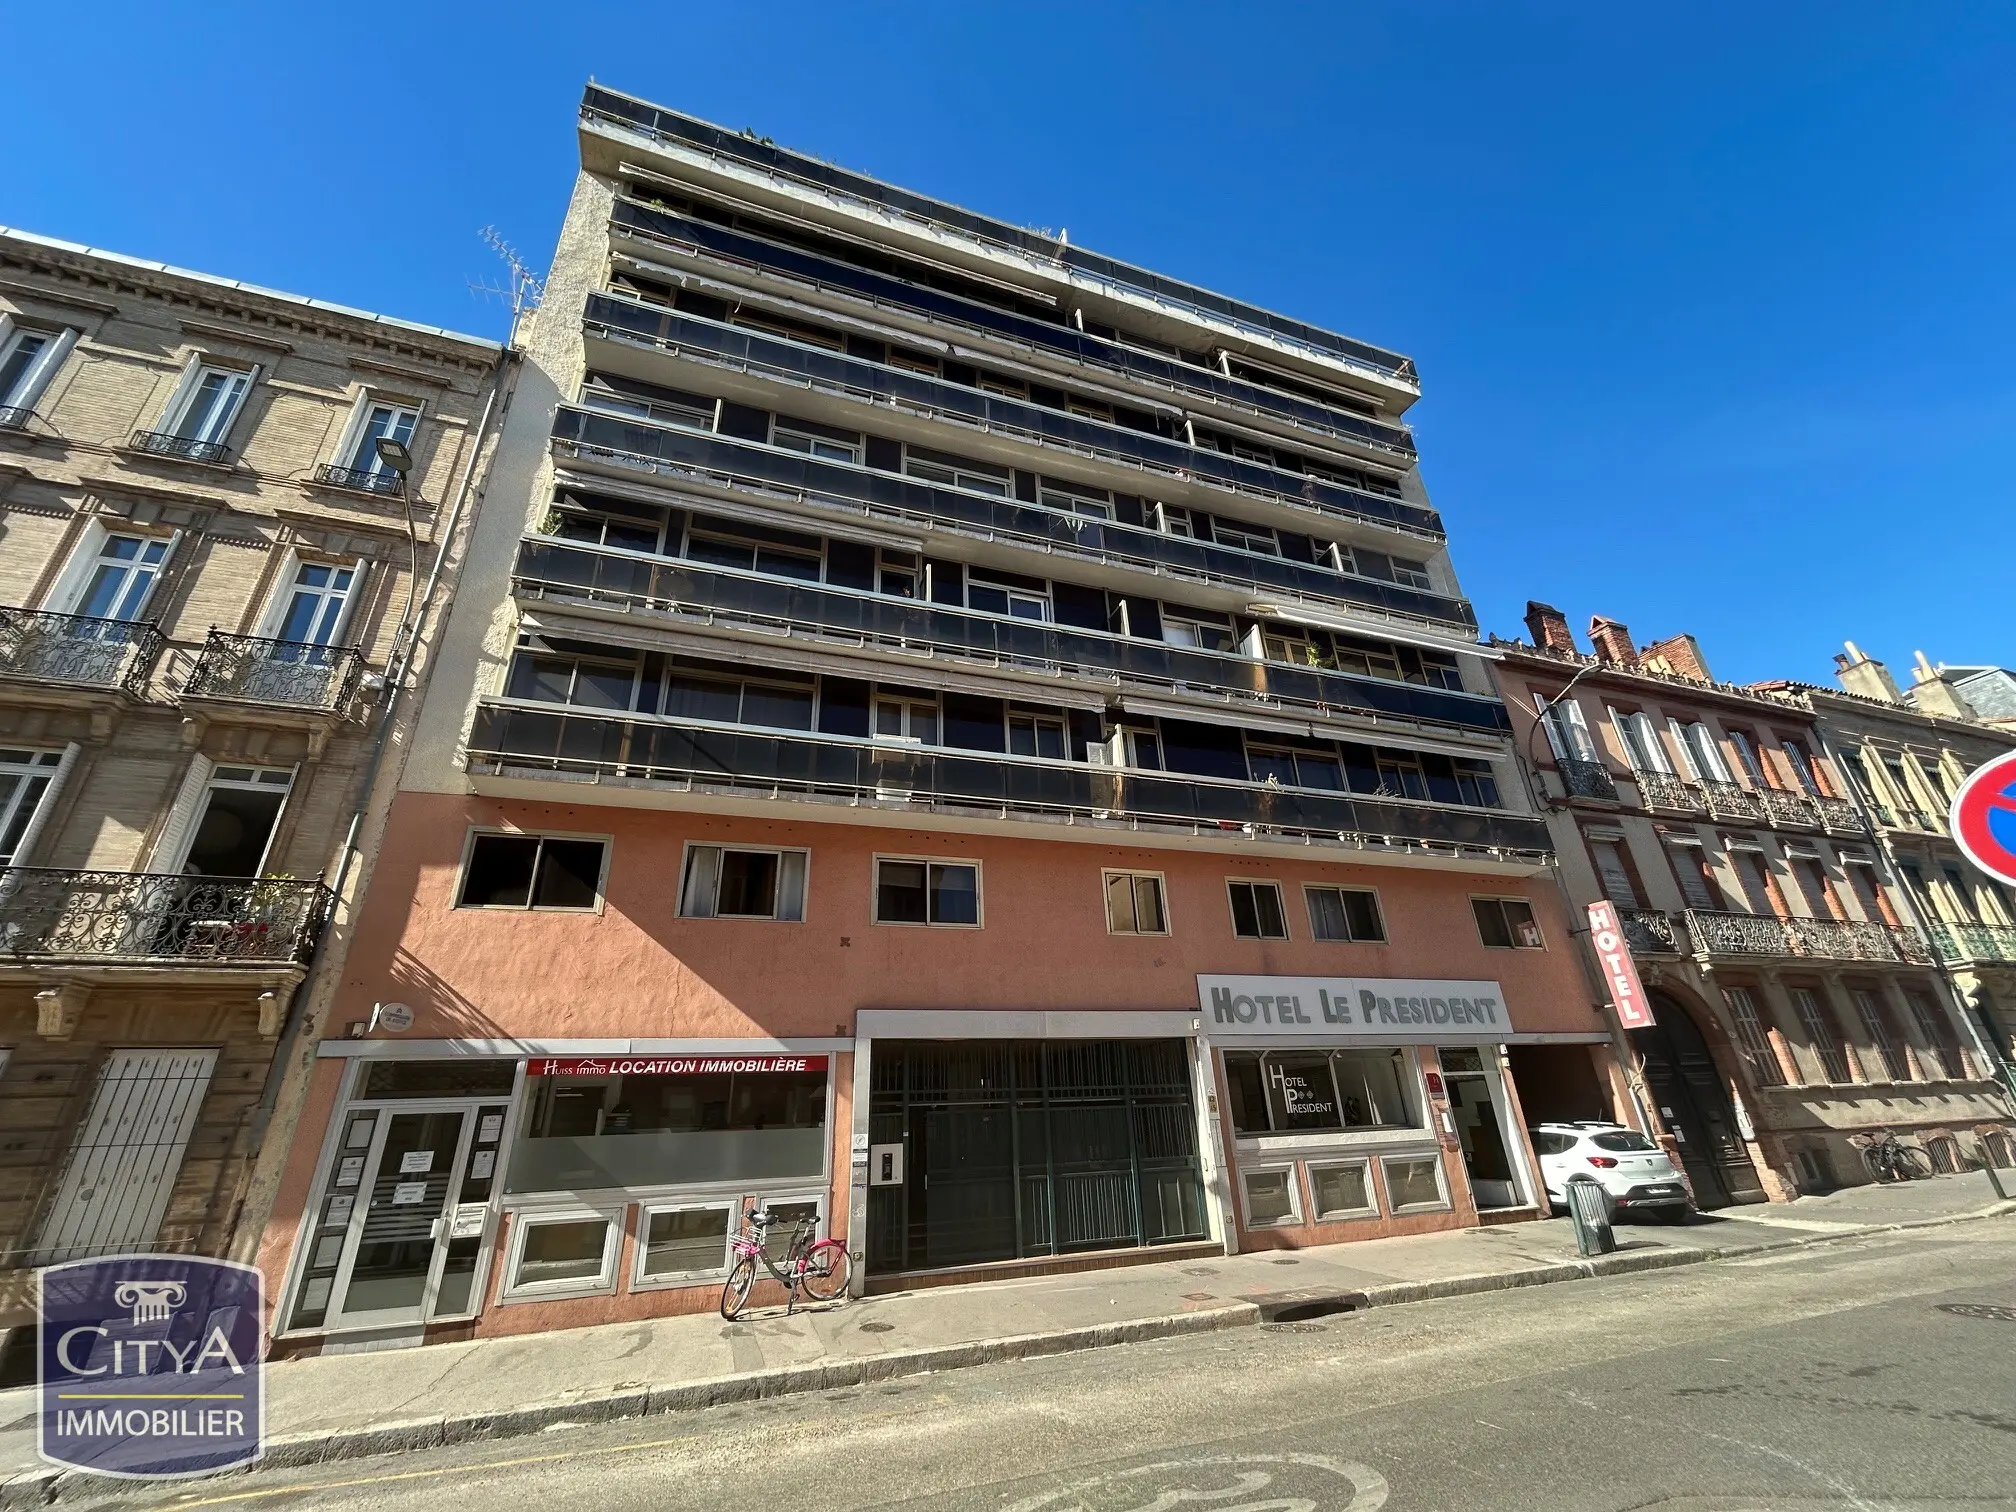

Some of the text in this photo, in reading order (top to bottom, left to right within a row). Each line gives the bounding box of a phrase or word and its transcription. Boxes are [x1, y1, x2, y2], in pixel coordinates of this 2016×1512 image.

[1588, 909, 1641, 1021] HOTEL
[1210, 986, 1498, 1024] HOTEL LE PRESIDENT
[576, 1065, 606, 1075] immo
[608, 1060, 696, 1074] LOCATION
[698, 1057, 807, 1073] IMMOBILIÈRE
[1269, 1064, 1307, 1096] HOTEL
[1286, 1088, 1332, 1114] PRESIDENT
